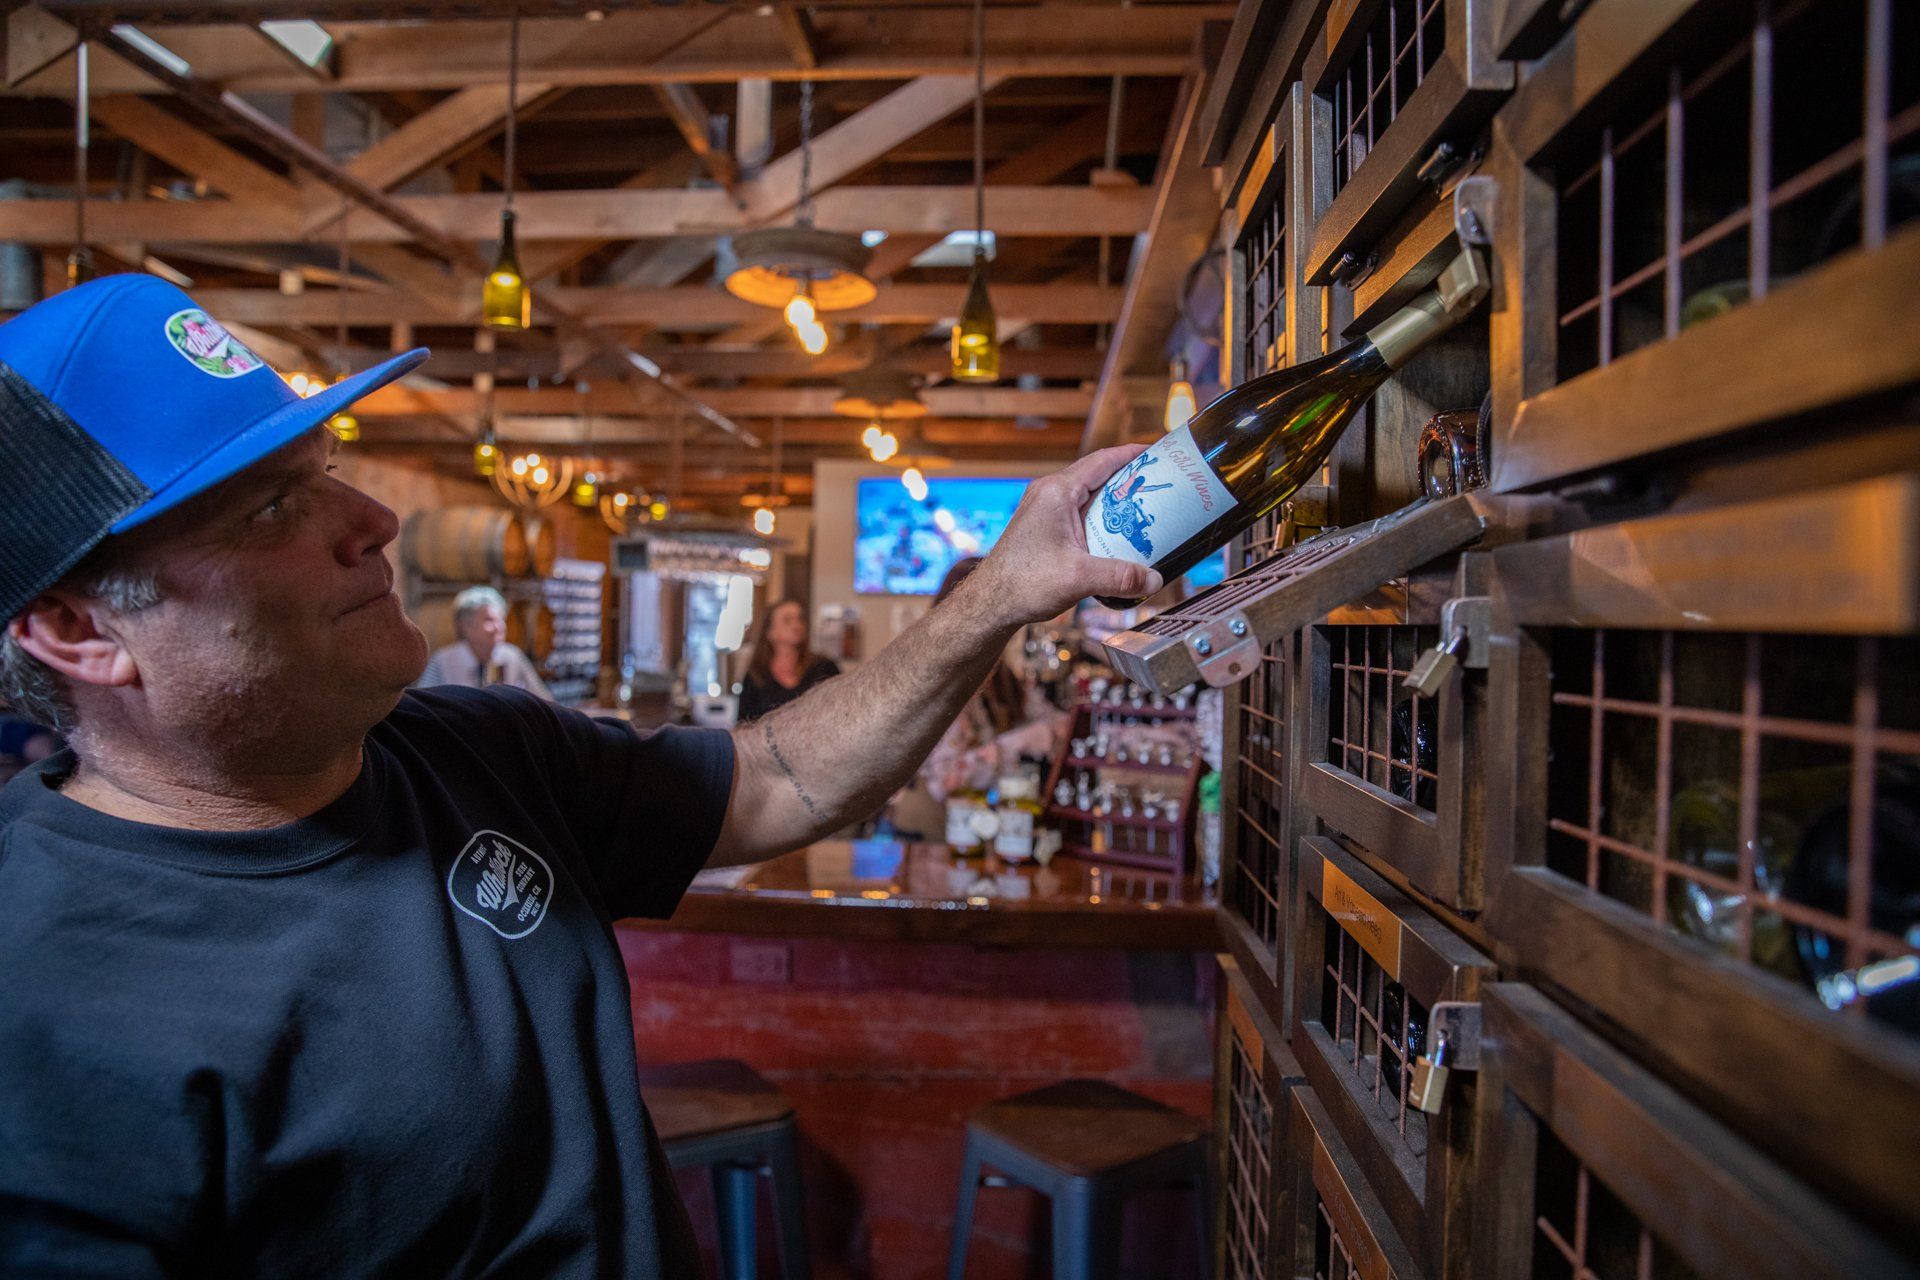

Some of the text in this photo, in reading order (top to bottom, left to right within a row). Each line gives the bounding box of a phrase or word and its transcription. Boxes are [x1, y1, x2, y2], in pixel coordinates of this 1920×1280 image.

[1186, 471, 1213, 512] Wines
[1087, 513, 1114, 558] HARDONN
[515, 861, 528, 877] SURF
[516, 867, 536, 893] COMPANY
[532, 884, 542, 896] CA
